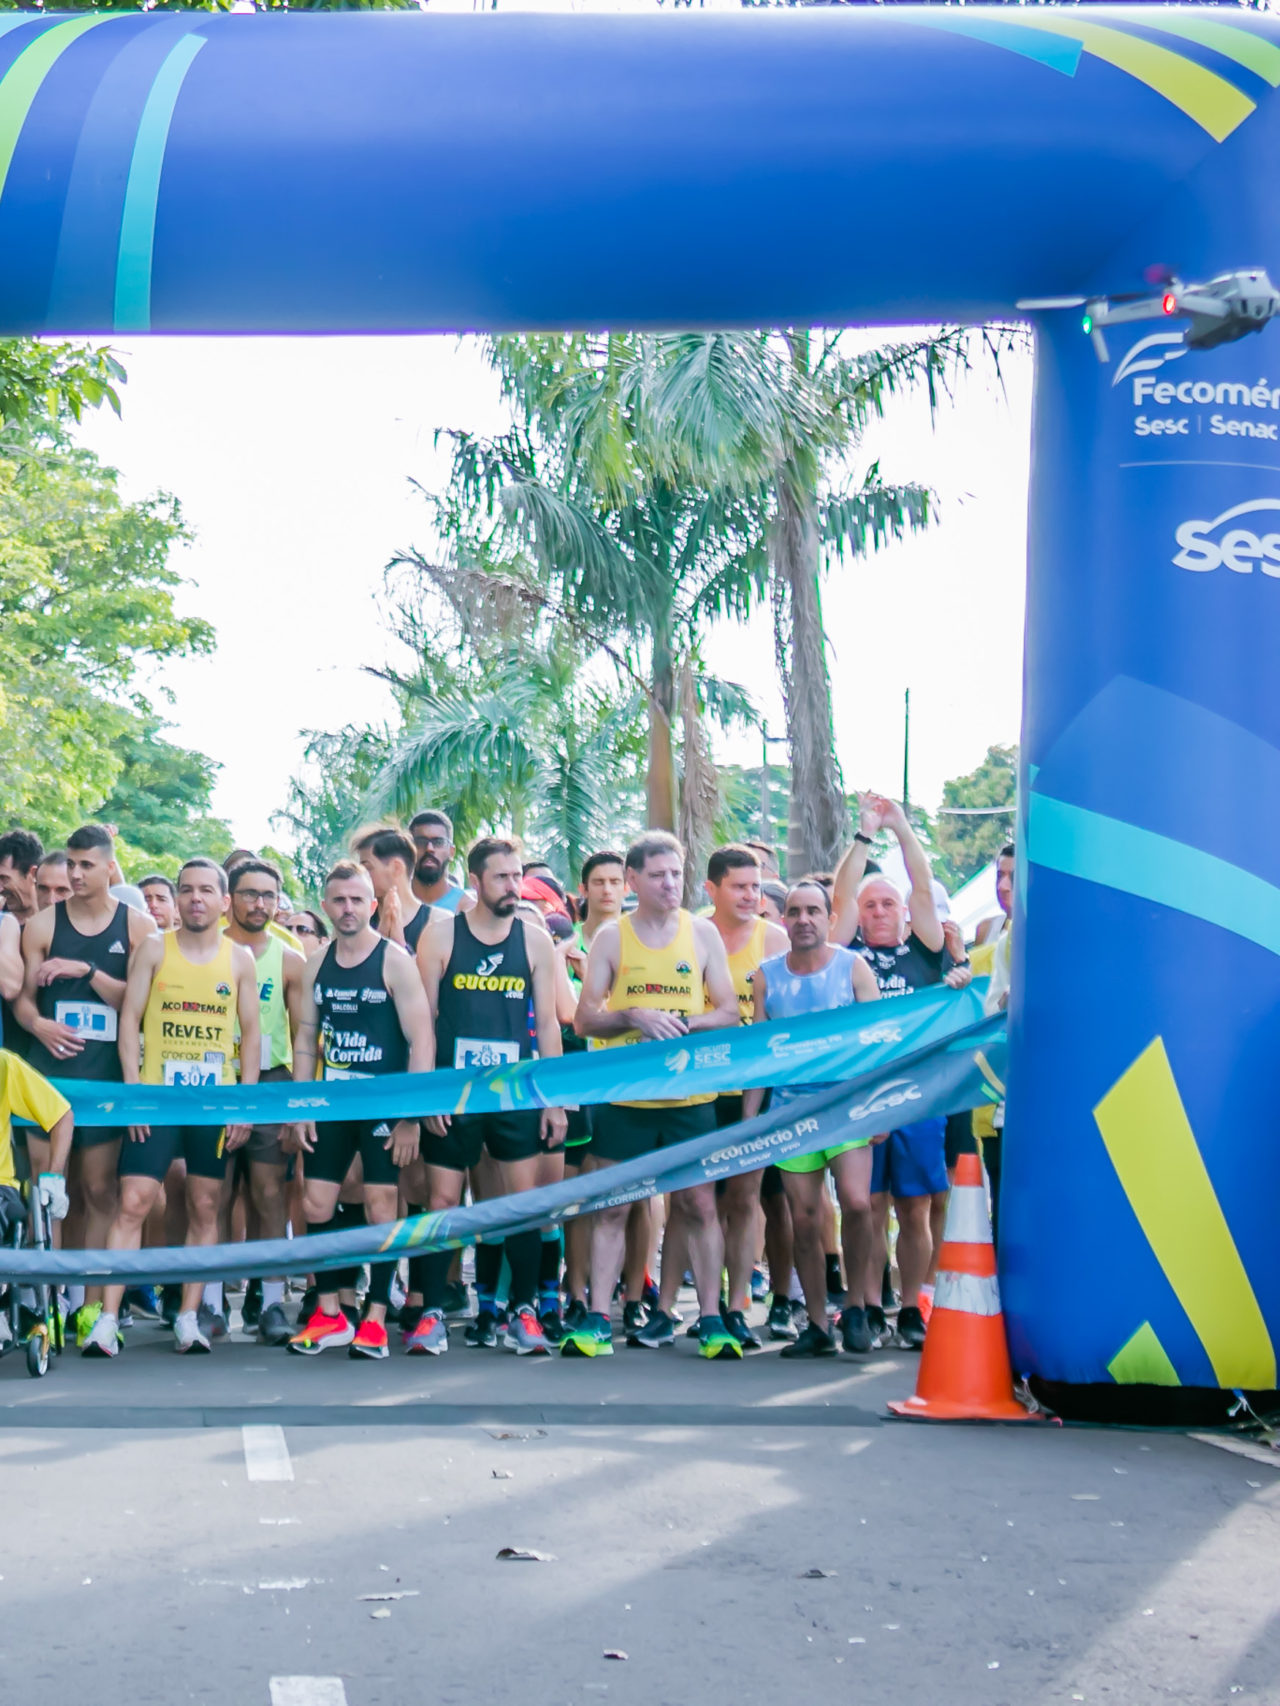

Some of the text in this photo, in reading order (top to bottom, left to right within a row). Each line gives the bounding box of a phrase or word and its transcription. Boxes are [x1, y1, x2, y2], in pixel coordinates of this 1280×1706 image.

[1133, 376, 1280, 410] Fecomér
[1134, 415, 1279, 441] Sesc Senac
[1171, 515, 1280, 579] Ses
[453, 973, 526, 992] eucorro
[162, 1021, 223, 1041] REVEST
[335, 1031, 367, 1048] Vida
[858, 1027, 903, 1046] Sesc
[330, 1045, 383, 1063] Corrida
[471, 1050, 501, 1067] 269
[180, 1071, 213, 1086] 307
[848, 1083, 922, 1122] Sesc
[793, 1117, 820, 1137] PR
[607, 1185, 658, 1207] CORRIDAS
